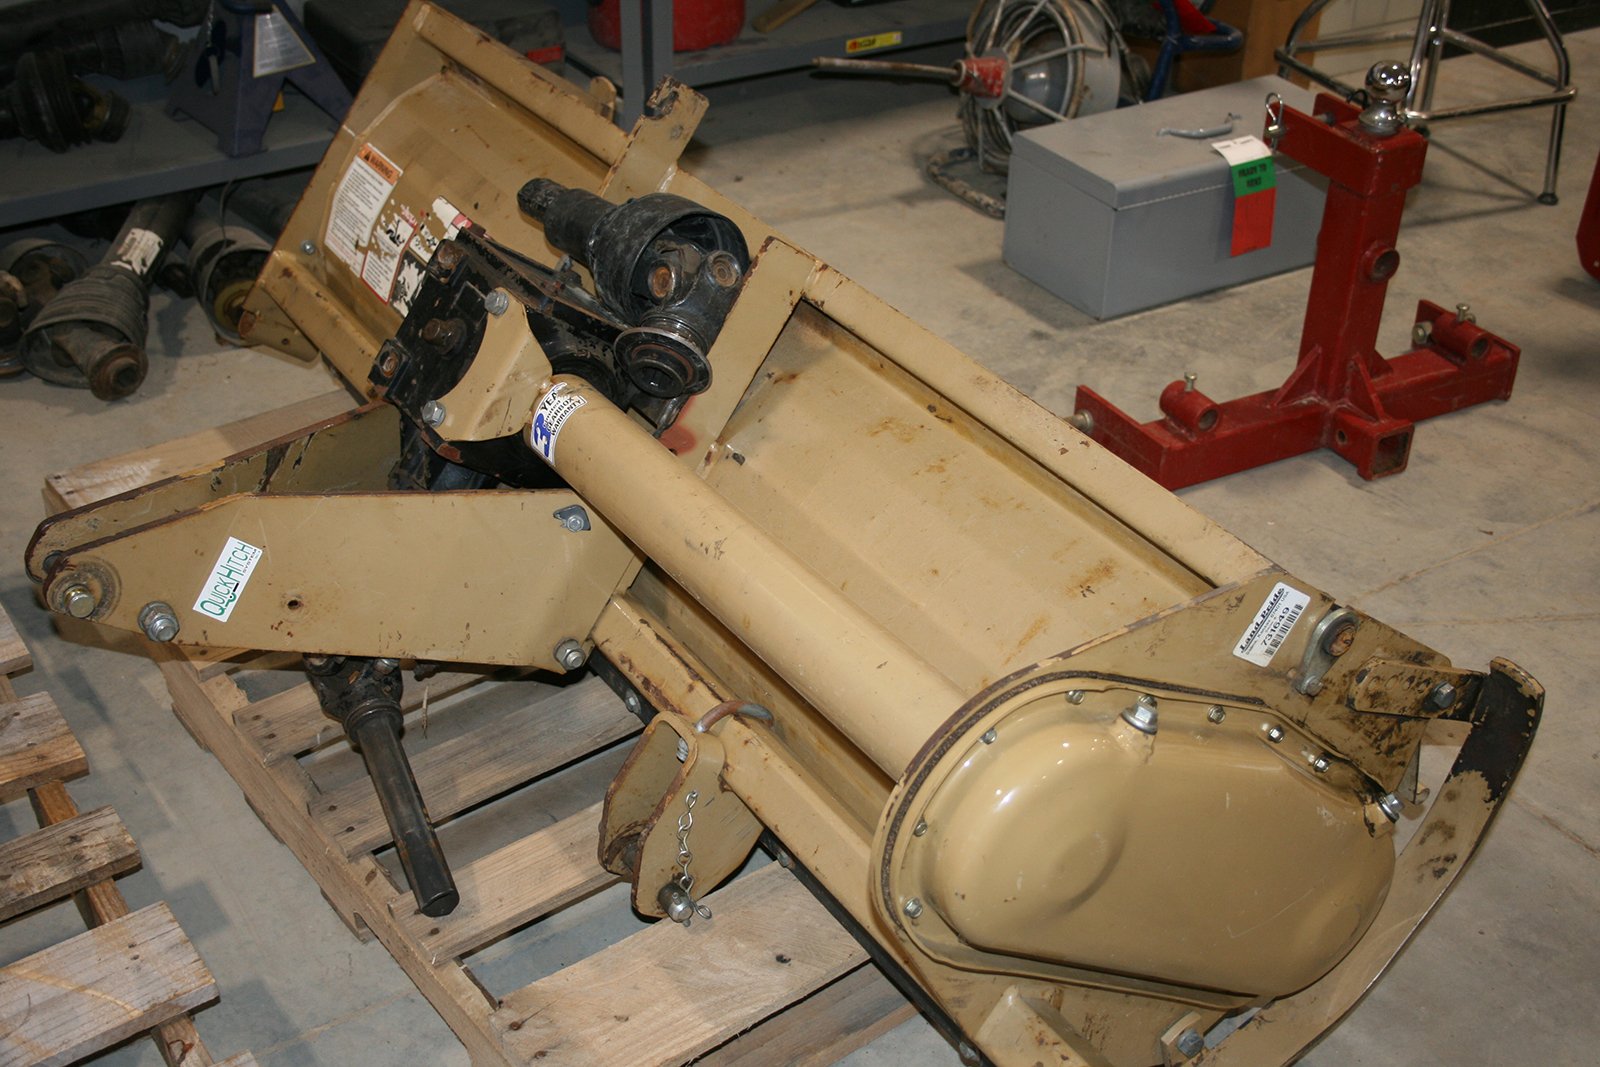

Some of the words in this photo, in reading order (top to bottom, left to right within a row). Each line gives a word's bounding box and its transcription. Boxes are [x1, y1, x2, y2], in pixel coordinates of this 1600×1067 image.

[541, 392, 558, 411] YEA
[551, 400, 582, 436] WARRANTY
[533, 413, 551, 457] 3
[1239, 622, 1261, 654] Land
[1260, 588, 1285, 620] Pride
[1260, 607, 1290, 646] 731649
